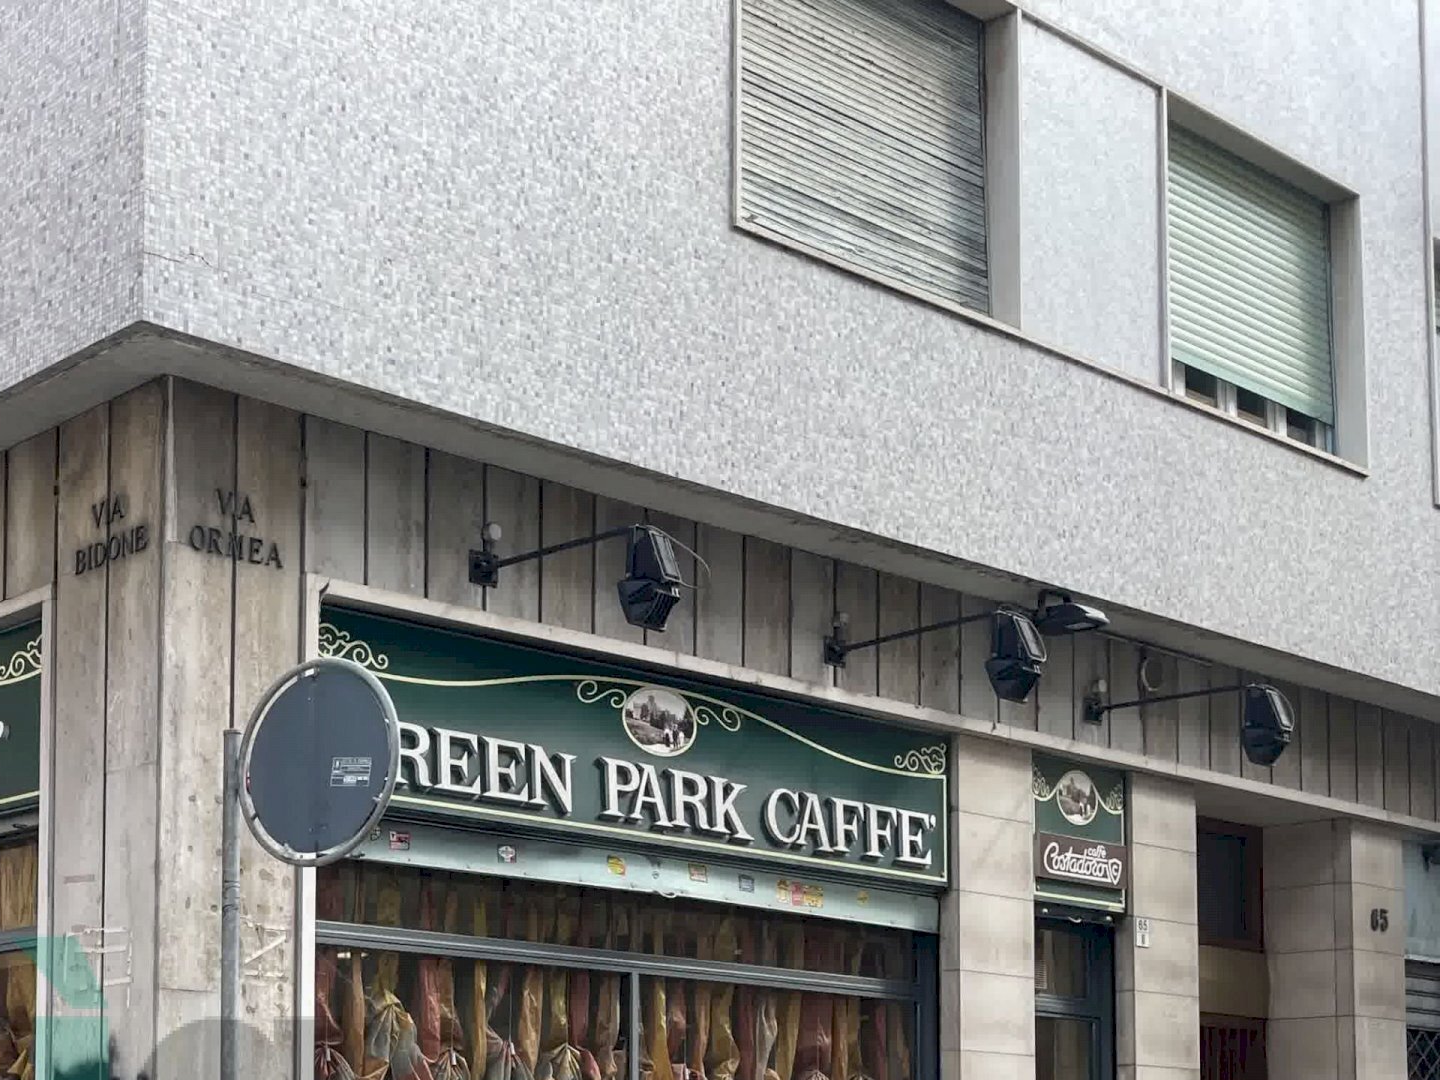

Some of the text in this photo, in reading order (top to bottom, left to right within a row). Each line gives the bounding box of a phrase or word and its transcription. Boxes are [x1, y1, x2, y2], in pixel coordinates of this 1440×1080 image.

[74, 525, 149, 576] BIDONE
[189, 524, 285, 569] ORMEA
[394, 720, 578, 817] REEN
[595, 755, 756, 843] PARK
[1043, 841, 1112, 883] Costadoro
[1370, 908, 1389, 933] 65
